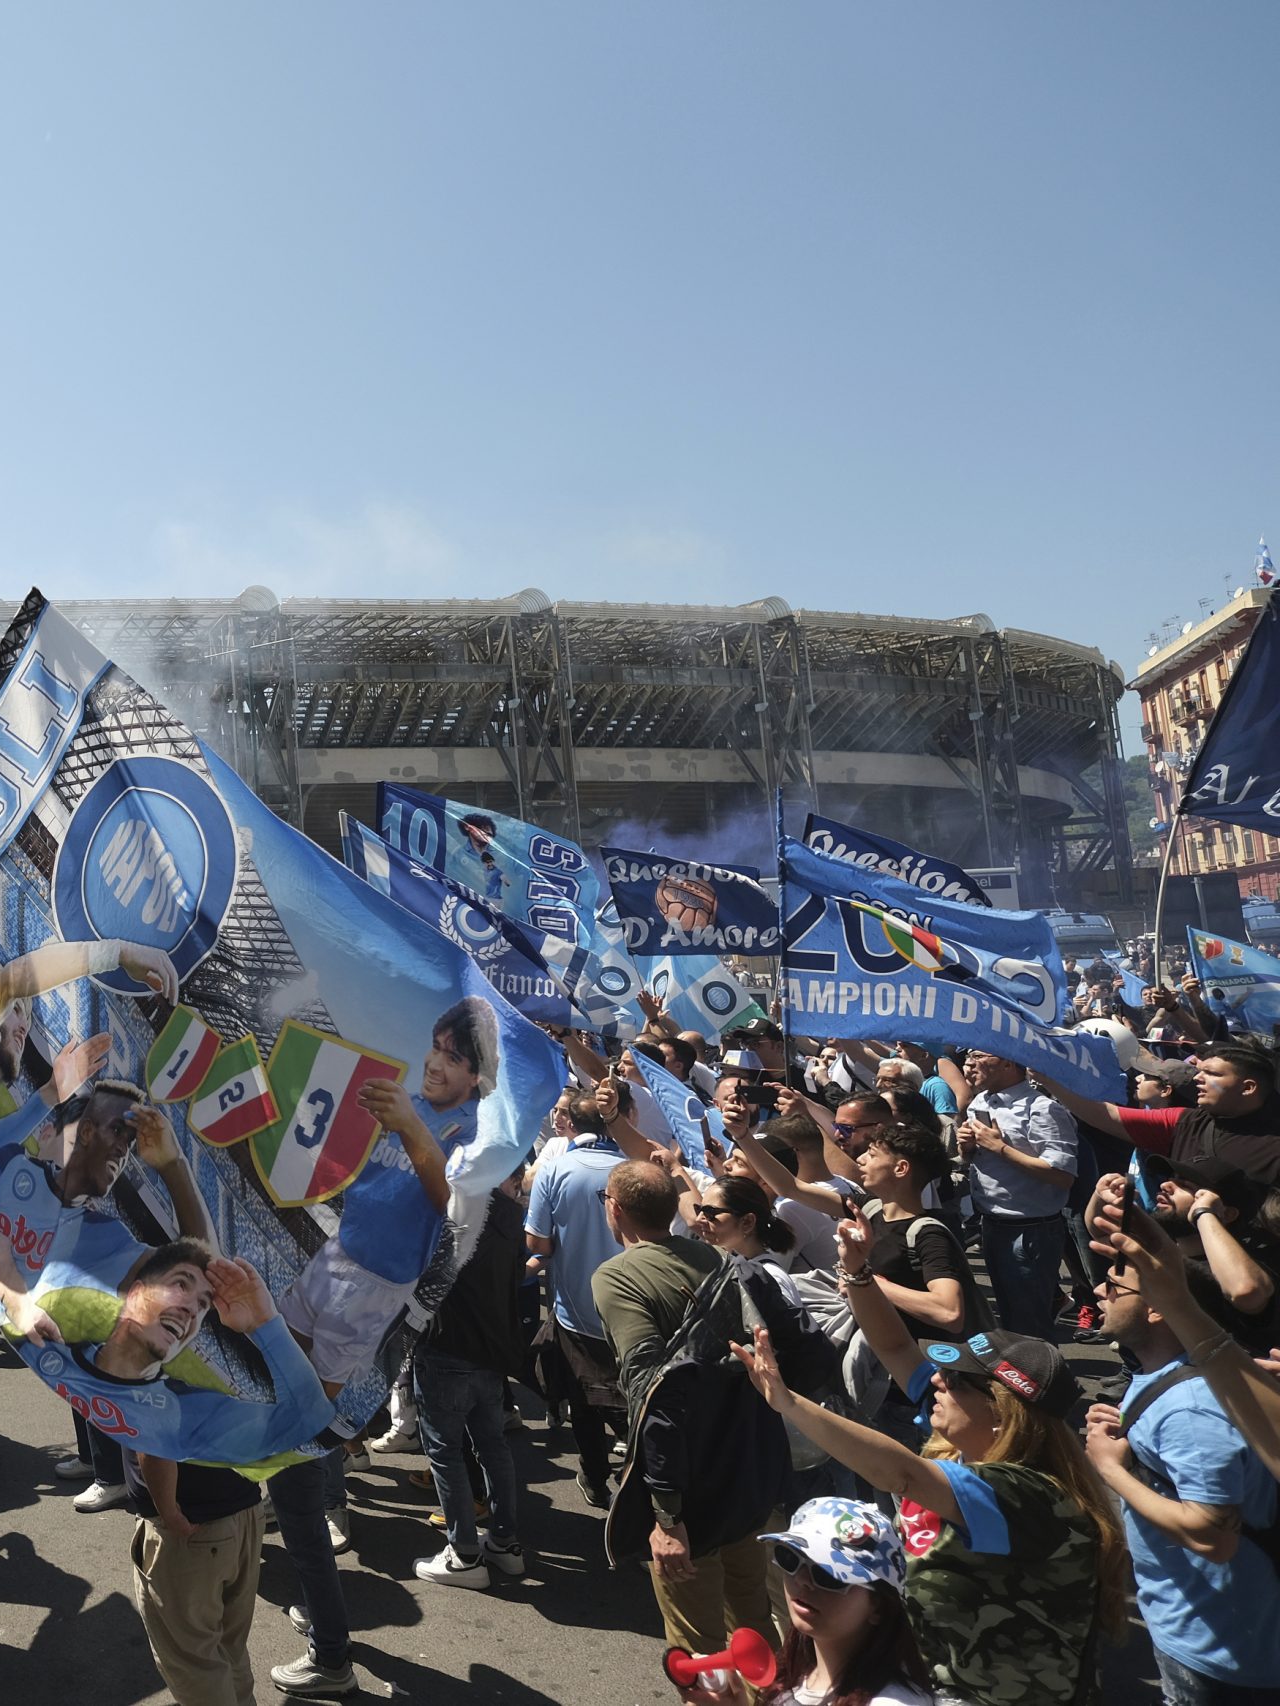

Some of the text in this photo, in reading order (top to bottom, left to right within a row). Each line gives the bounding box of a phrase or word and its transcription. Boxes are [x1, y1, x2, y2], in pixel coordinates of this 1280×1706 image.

[381, 802, 439, 868] 10
[166, 1049, 189, 1080] 1
[218, 1082, 245, 1112] 2
[294, 1088, 335, 1150] 3
[998, 1369, 1035, 1394] Lete
